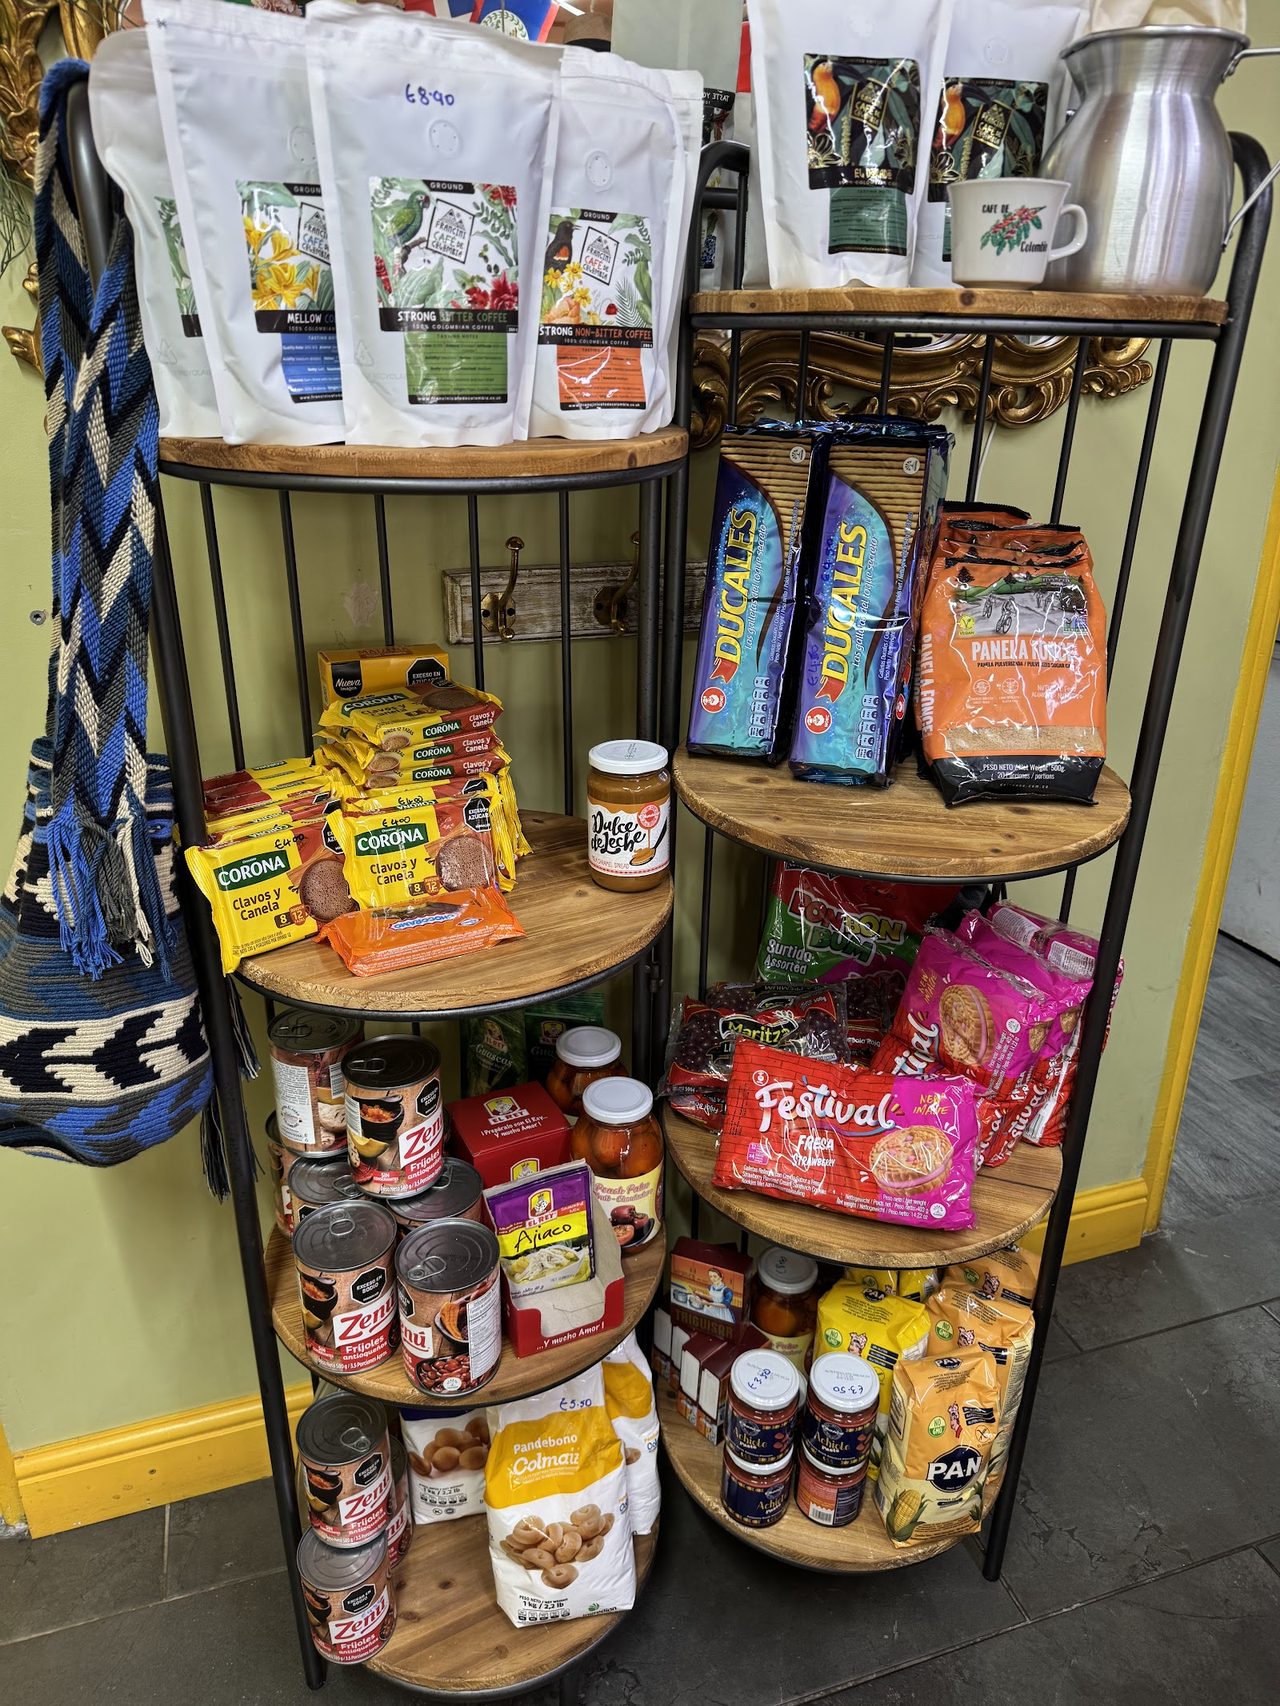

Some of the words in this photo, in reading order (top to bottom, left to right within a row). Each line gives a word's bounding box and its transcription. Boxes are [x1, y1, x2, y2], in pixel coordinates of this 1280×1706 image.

[429, 182, 464, 191] GROUND
[583, 211, 611, 220] GROUND
[982, 204, 998, 214] CAFE
[1001, 204, 1010, 214] DE
[435, 221, 467, 240] FRANCINI
[287, 312, 322, 324] MELLOW
[397, 311, 437, 322] STRONG
[476, 312, 508, 323] COFFEE
[539, 326, 573, 336] STRONG
[574, 327, 623, 339] NON-BITTER
[624, 329, 652, 340] COFFEE
[755, 524, 767, 556] secreto
[866, 537, 879, 571] secreto
[752, 557, 764, 583] toque
[714, 506, 758, 666] DUCALES
[750, 583, 760, 598] del
[862, 572, 876, 599] toque
[821, 519, 868, 683] DUCALES
[860, 600, 869, 614] del
[745, 599, 759, 635] galletas
[744, 636, 753, 650] Las
[971, 639, 1031, 662] PANELA
[851, 651, 861, 667] Las
[878, 660, 886, 679] Galletas
[335, 678, 362, 688] Nueva
[343, 694, 405, 711] CORONA
[469, 713, 491, 722] Clavos
[472, 718, 493, 728] Canela
[425, 722, 460, 737] CORONA
[462, 738, 485, 747] Clavos
[465, 743, 488, 753] Canela
[416, 746, 452, 759] CORONA
[415, 768, 452, 779] CORONA
[463, 761, 485, 770] Clavos
[983, 764, 998, 772] PESO
[1034, 772, 1055, 780] portions
[591, 810, 639, 836] Dulce
[357, 827, 424, 851] CORONA
[591, 832, 603, 853] de
[600, 831, 647, 855] Leche
[218, 855, 286, 887] CORONA
[370, 860, 407, 875] Clavos
[409, 857, 417, 869] y
[376, 870, 414, 886] Canela
[414, 884, 421, 892] 8
[426, 882, 437, 891] 12
[233, 889, 271, 911] Clavos
[273, 888, 281, 900] y
[240, 901, 280, 921] Canela
[280, 913, 287, 924] 8
[291, 911, 303, 921] 12
[789, 890, 844, 929] BON
[843, 914, 904, 941] BON
[394, 913, 457, 929] CHOCORAMO
[766, 939, 813, 962] Surtido
[810, 926, 874, 963] BUM
[764, 955, 807, 975] Assorted
[893, 1012, 940, 1075] tival
[475, 1043, 513, 1067] Guascas
[919, 1092, 946, 1105] NEW
[754, 1081, 896, 1133] Festival
[492, 1116, 502, 1125] EL
[504, 1110, 526, 1122] REY
[513, 1120, 525, 1128] con
[501, 1126, 521, 1137] mucho
[521, 1122, 538, 1132] Amor
[798, 1134, 835, 1152] FRESA
[792, 1153, 836, 1167] STRAWBERRY
[528, 1218, 539, 1227] EL
[538, 1213, 554, 1224] REY
[514, 1222, 572, 1253] Ajiaco
[356, 1279, 376, 1291] EXCESO
[376, 1274, 383, 1282] EN
[361, 1282, 379, 1294] SODIO
[339, 1292, 395, 1341] Zenú
[675, 1308, 734, 1340] TRIGUISAR
[551, 1331, 578, 1345] mucho
[578, 1324, 600, 1336] Amor
[830, 1330, 838, 1338] NO
[938, 1330, 951, 1339] GMO
[941, 1323, 949, 1331] NO
[404, 1326, 426, 1348] nú
[343, 1341, 388, 1360] antioqueños
[933, 1418, 941, 1427] NO
[734, 1427, 767, 1448] Achiote
[931, 1427, 944, 1436] GMO
[512, 1434, 578, 1454] Pandebono
[739, 1441, 757, 1450] Paste
[815, 1431, 850, 1451] Achiote
[821, 1445, 840, 1453] Paste
